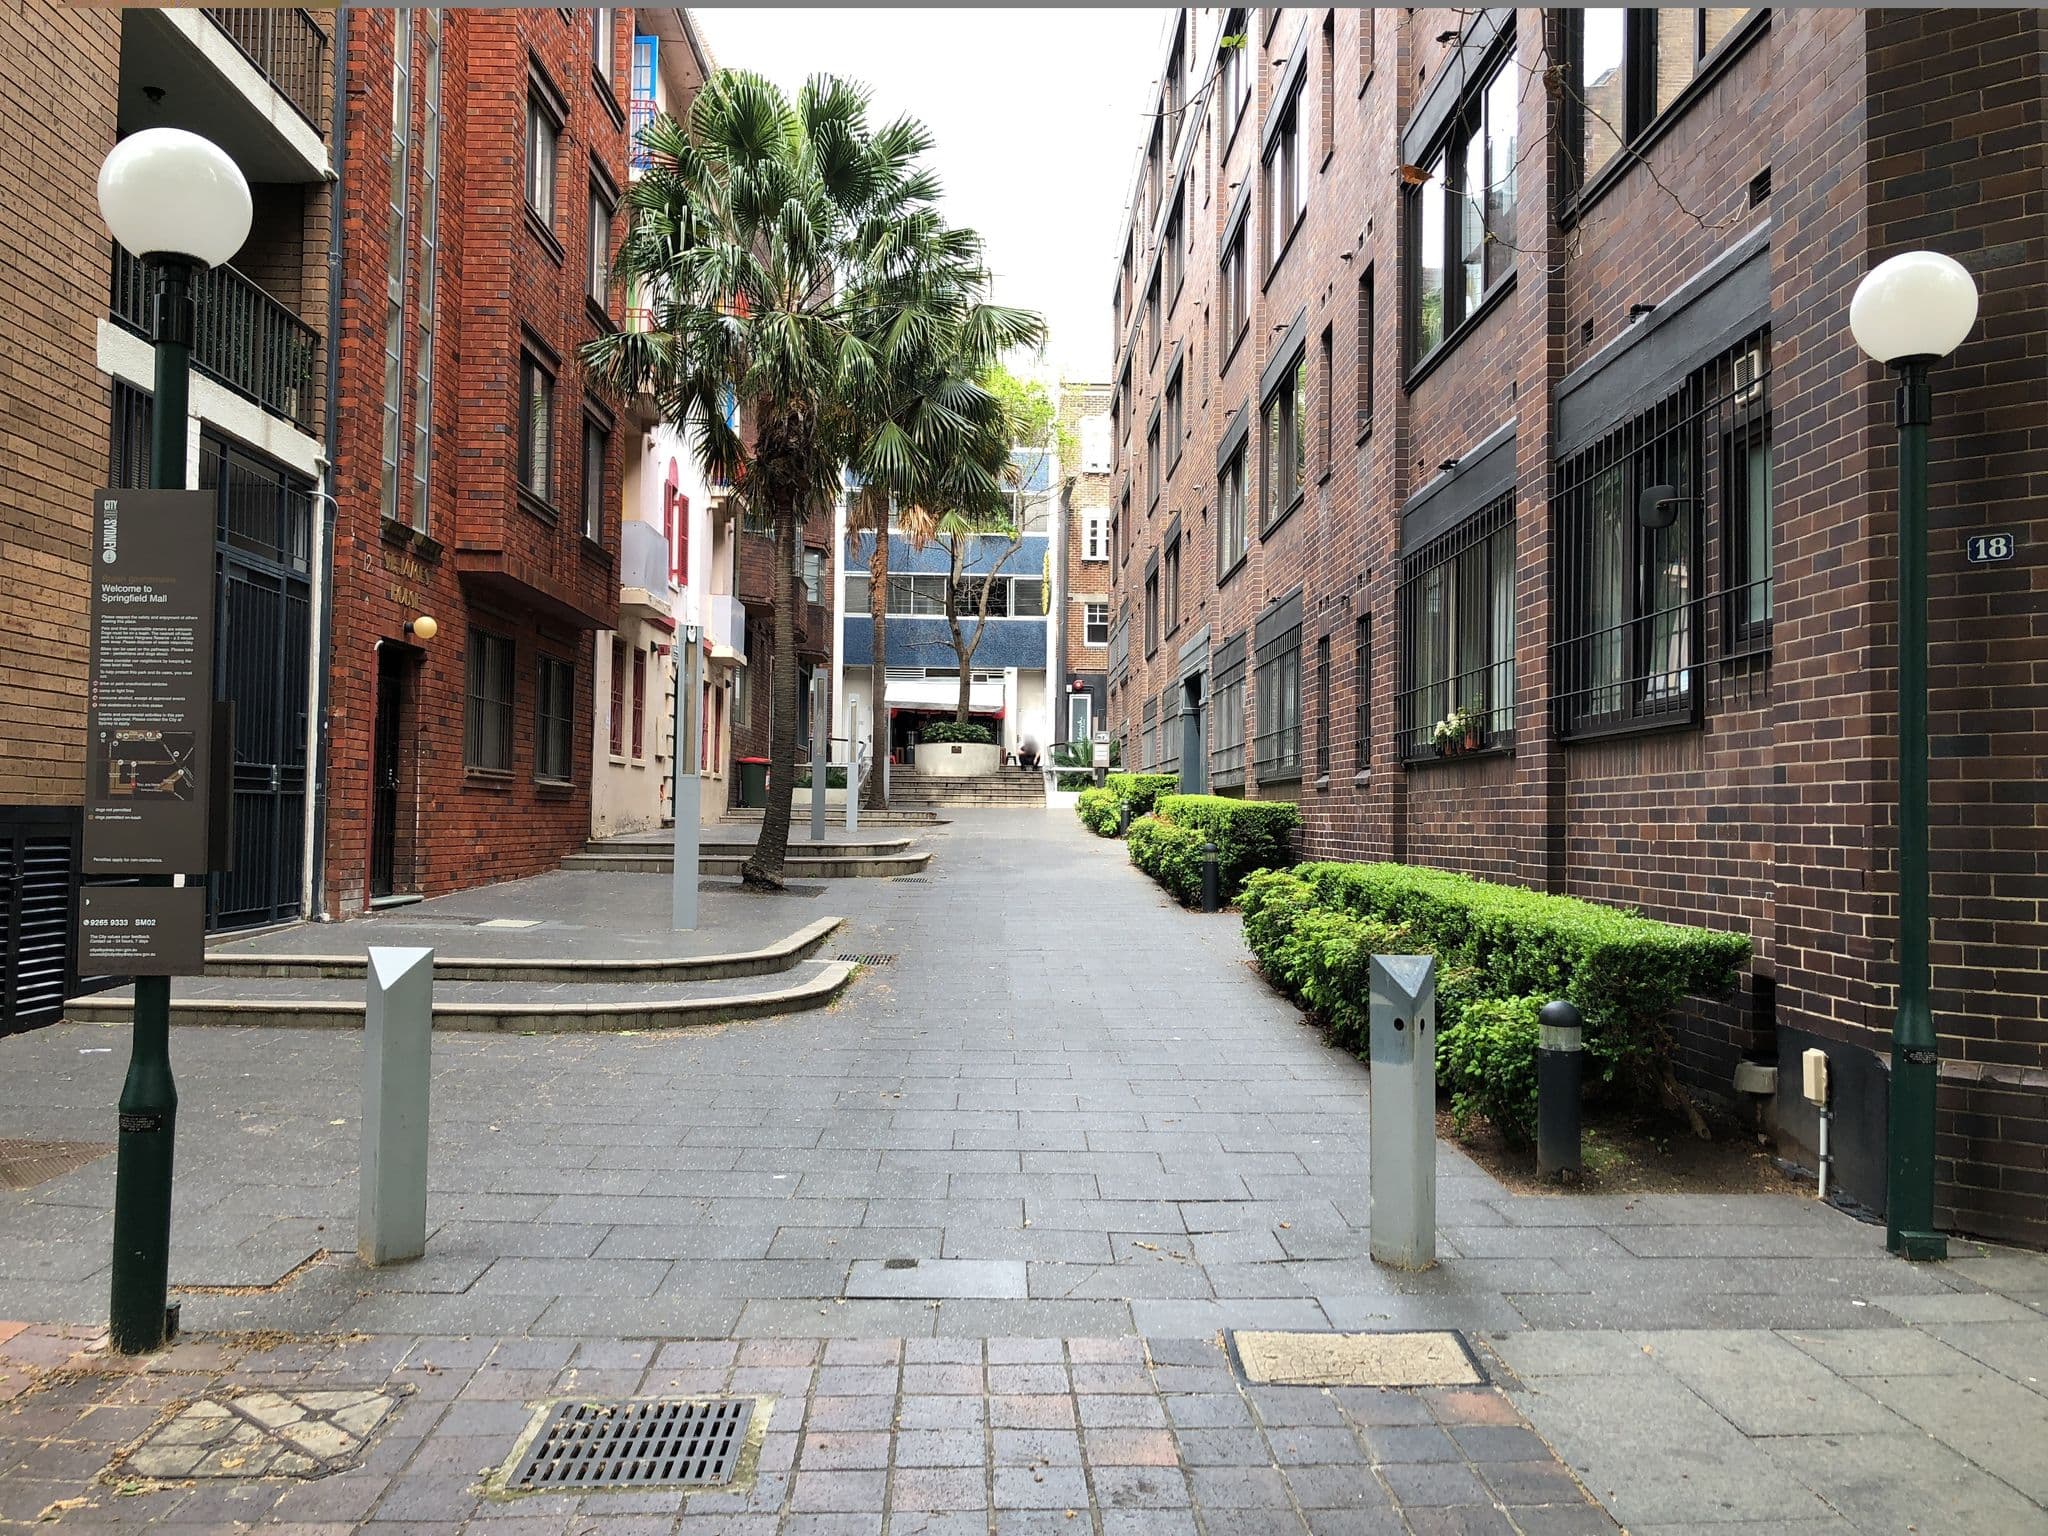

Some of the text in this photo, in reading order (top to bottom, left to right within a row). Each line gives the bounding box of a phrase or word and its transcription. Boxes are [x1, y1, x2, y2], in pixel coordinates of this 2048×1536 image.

[104, 519, 117, 550] SYDNEY
[1976, 538, 2008, 559] 18
[102, 584, 141, 592] Welcome
[101, 594, 168, 604] Springfield Mall
